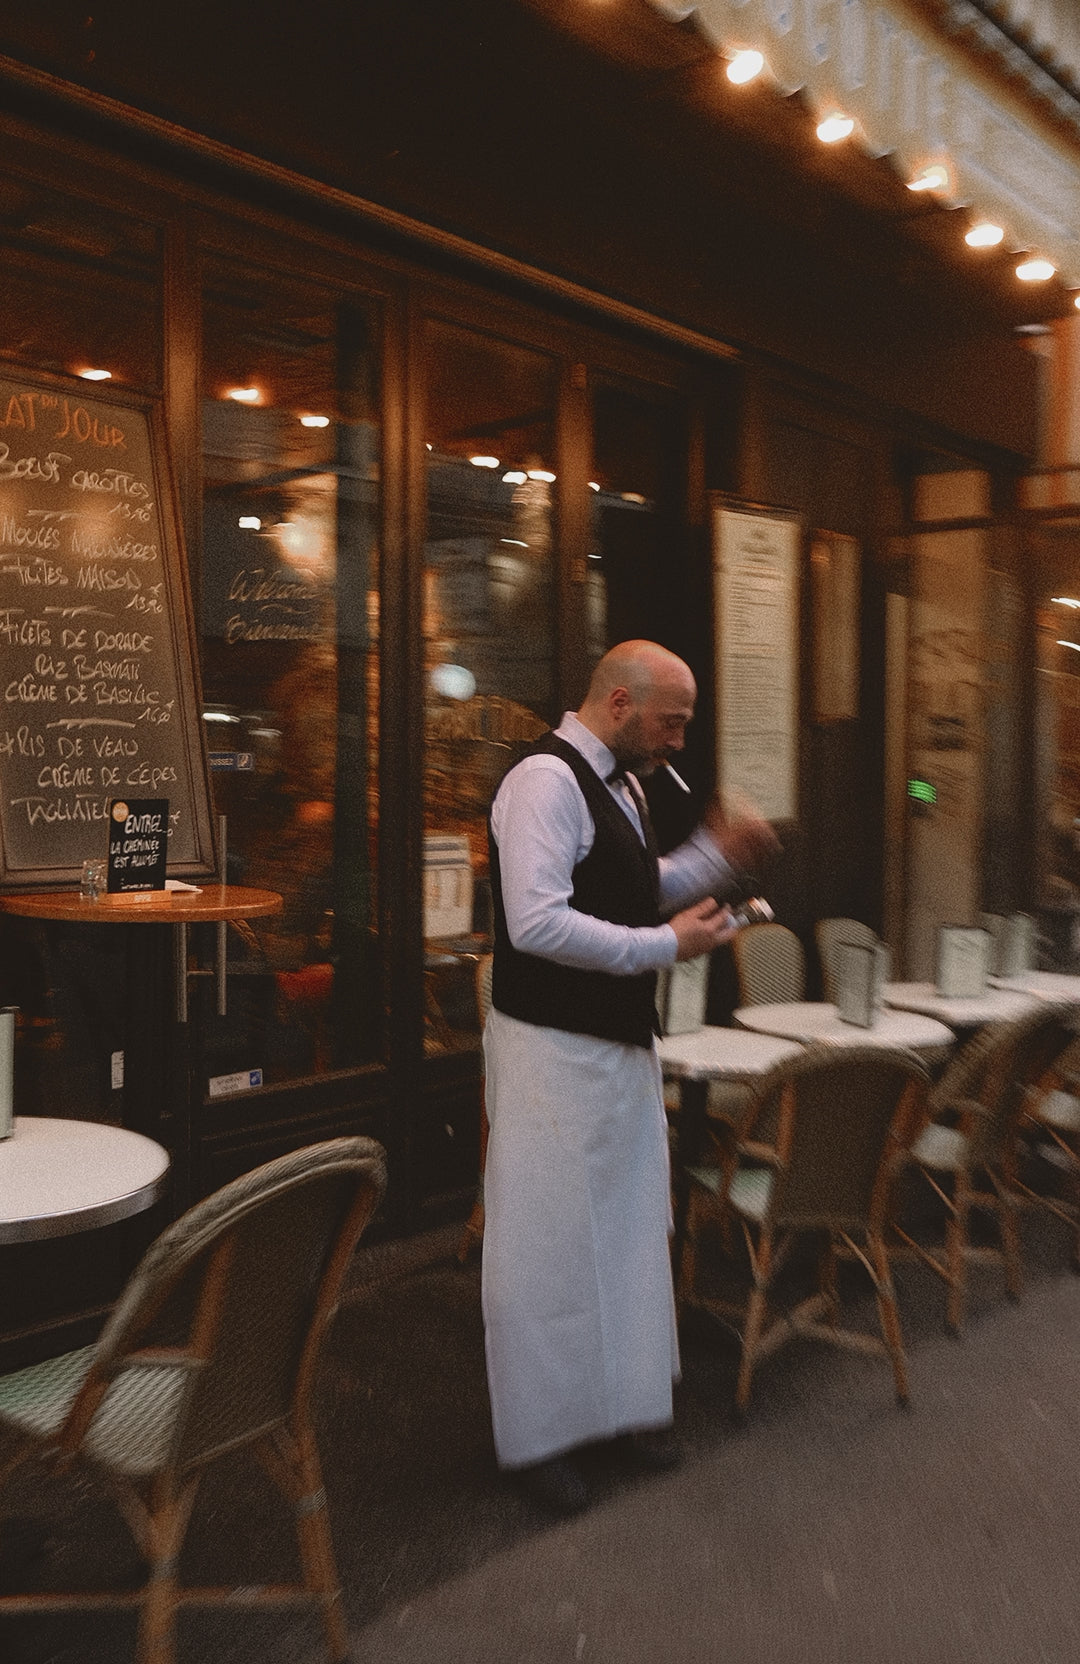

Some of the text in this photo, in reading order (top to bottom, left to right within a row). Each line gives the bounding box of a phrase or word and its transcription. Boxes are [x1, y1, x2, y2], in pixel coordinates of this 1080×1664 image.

[56, 400, 127, 449] JOUR
[2, 516, 60, 549] MOULES
[77, 563, 142, 592] MAISON
[62, 628, 88, 649] DE
[95, 630, 154, 652] DORADE
[73, 654, 142, 681] BASMATI
[65, 683, 88, 704] DE
[93, 681, 160, 705] BASILIC
[17, 725, 139, 759] RIS DE VEAU
[101, 766, 121, 788] DE
[110, 841, 121, 855] LA
[113, 856, 130, 869] EST
